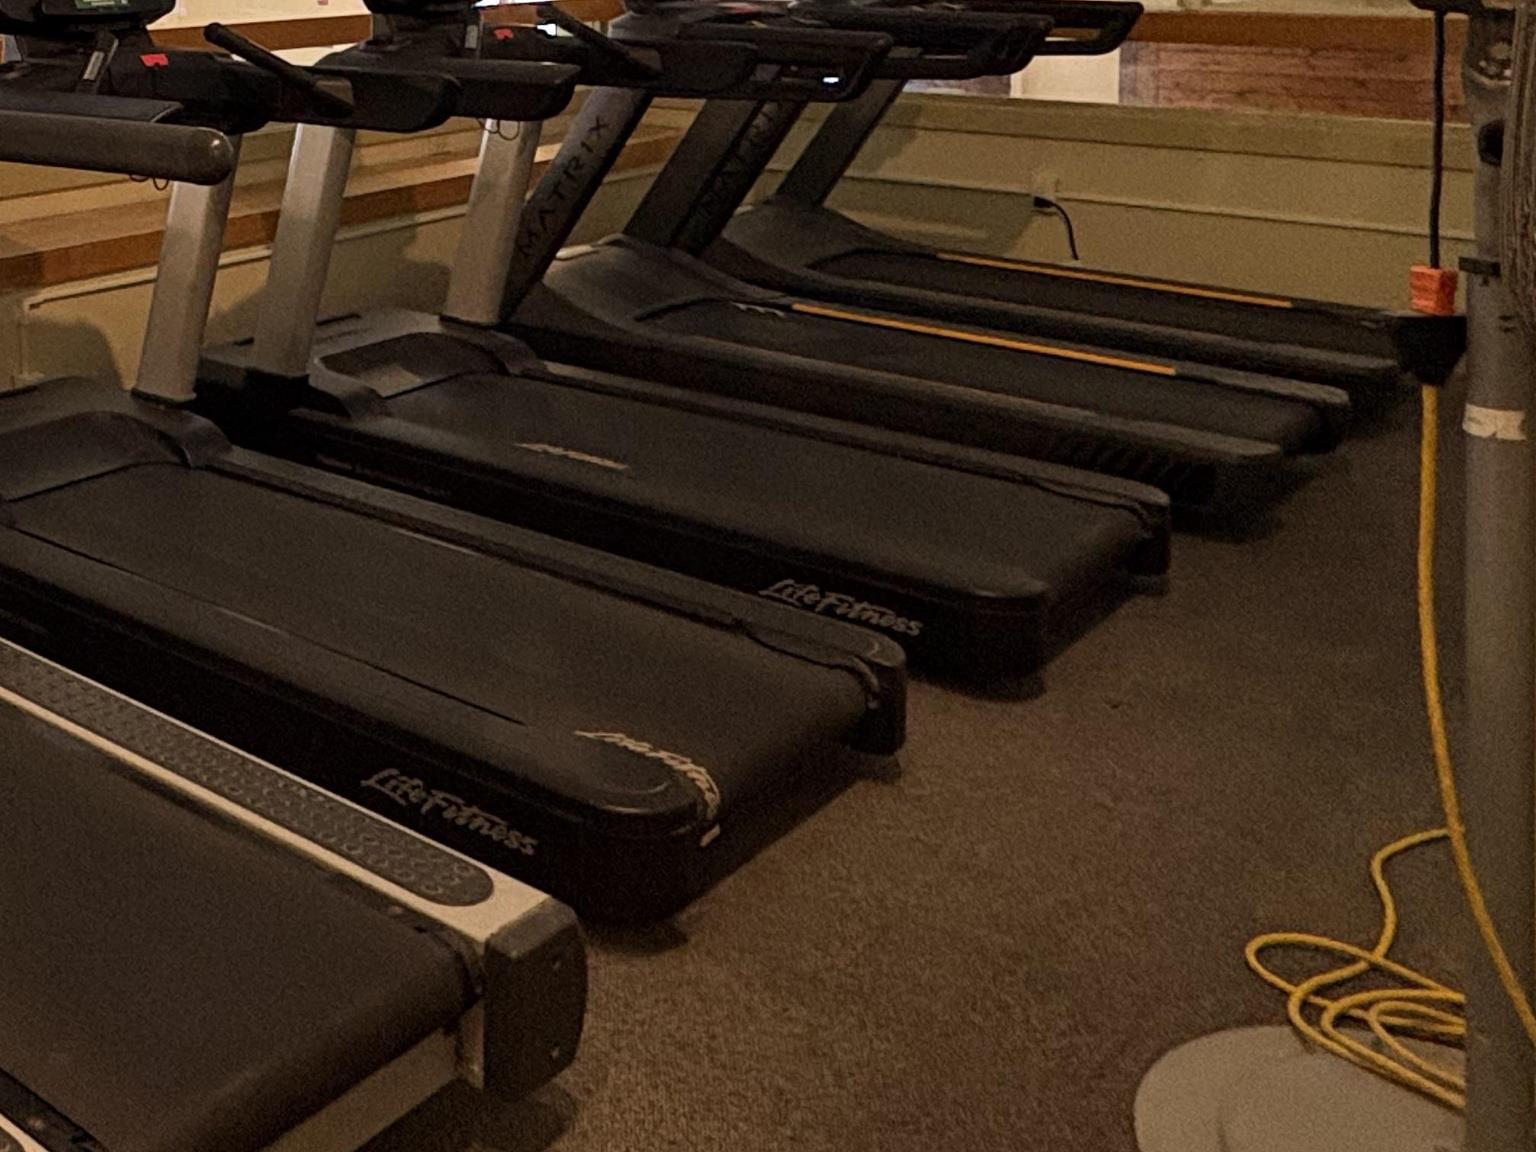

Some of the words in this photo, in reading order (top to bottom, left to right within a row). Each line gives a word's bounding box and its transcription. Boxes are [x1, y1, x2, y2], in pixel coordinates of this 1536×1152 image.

[815, 591, 923, 636] Fitness
[361, 768, 431, 807] Life
[420, 789, 538, 855] Fitness
